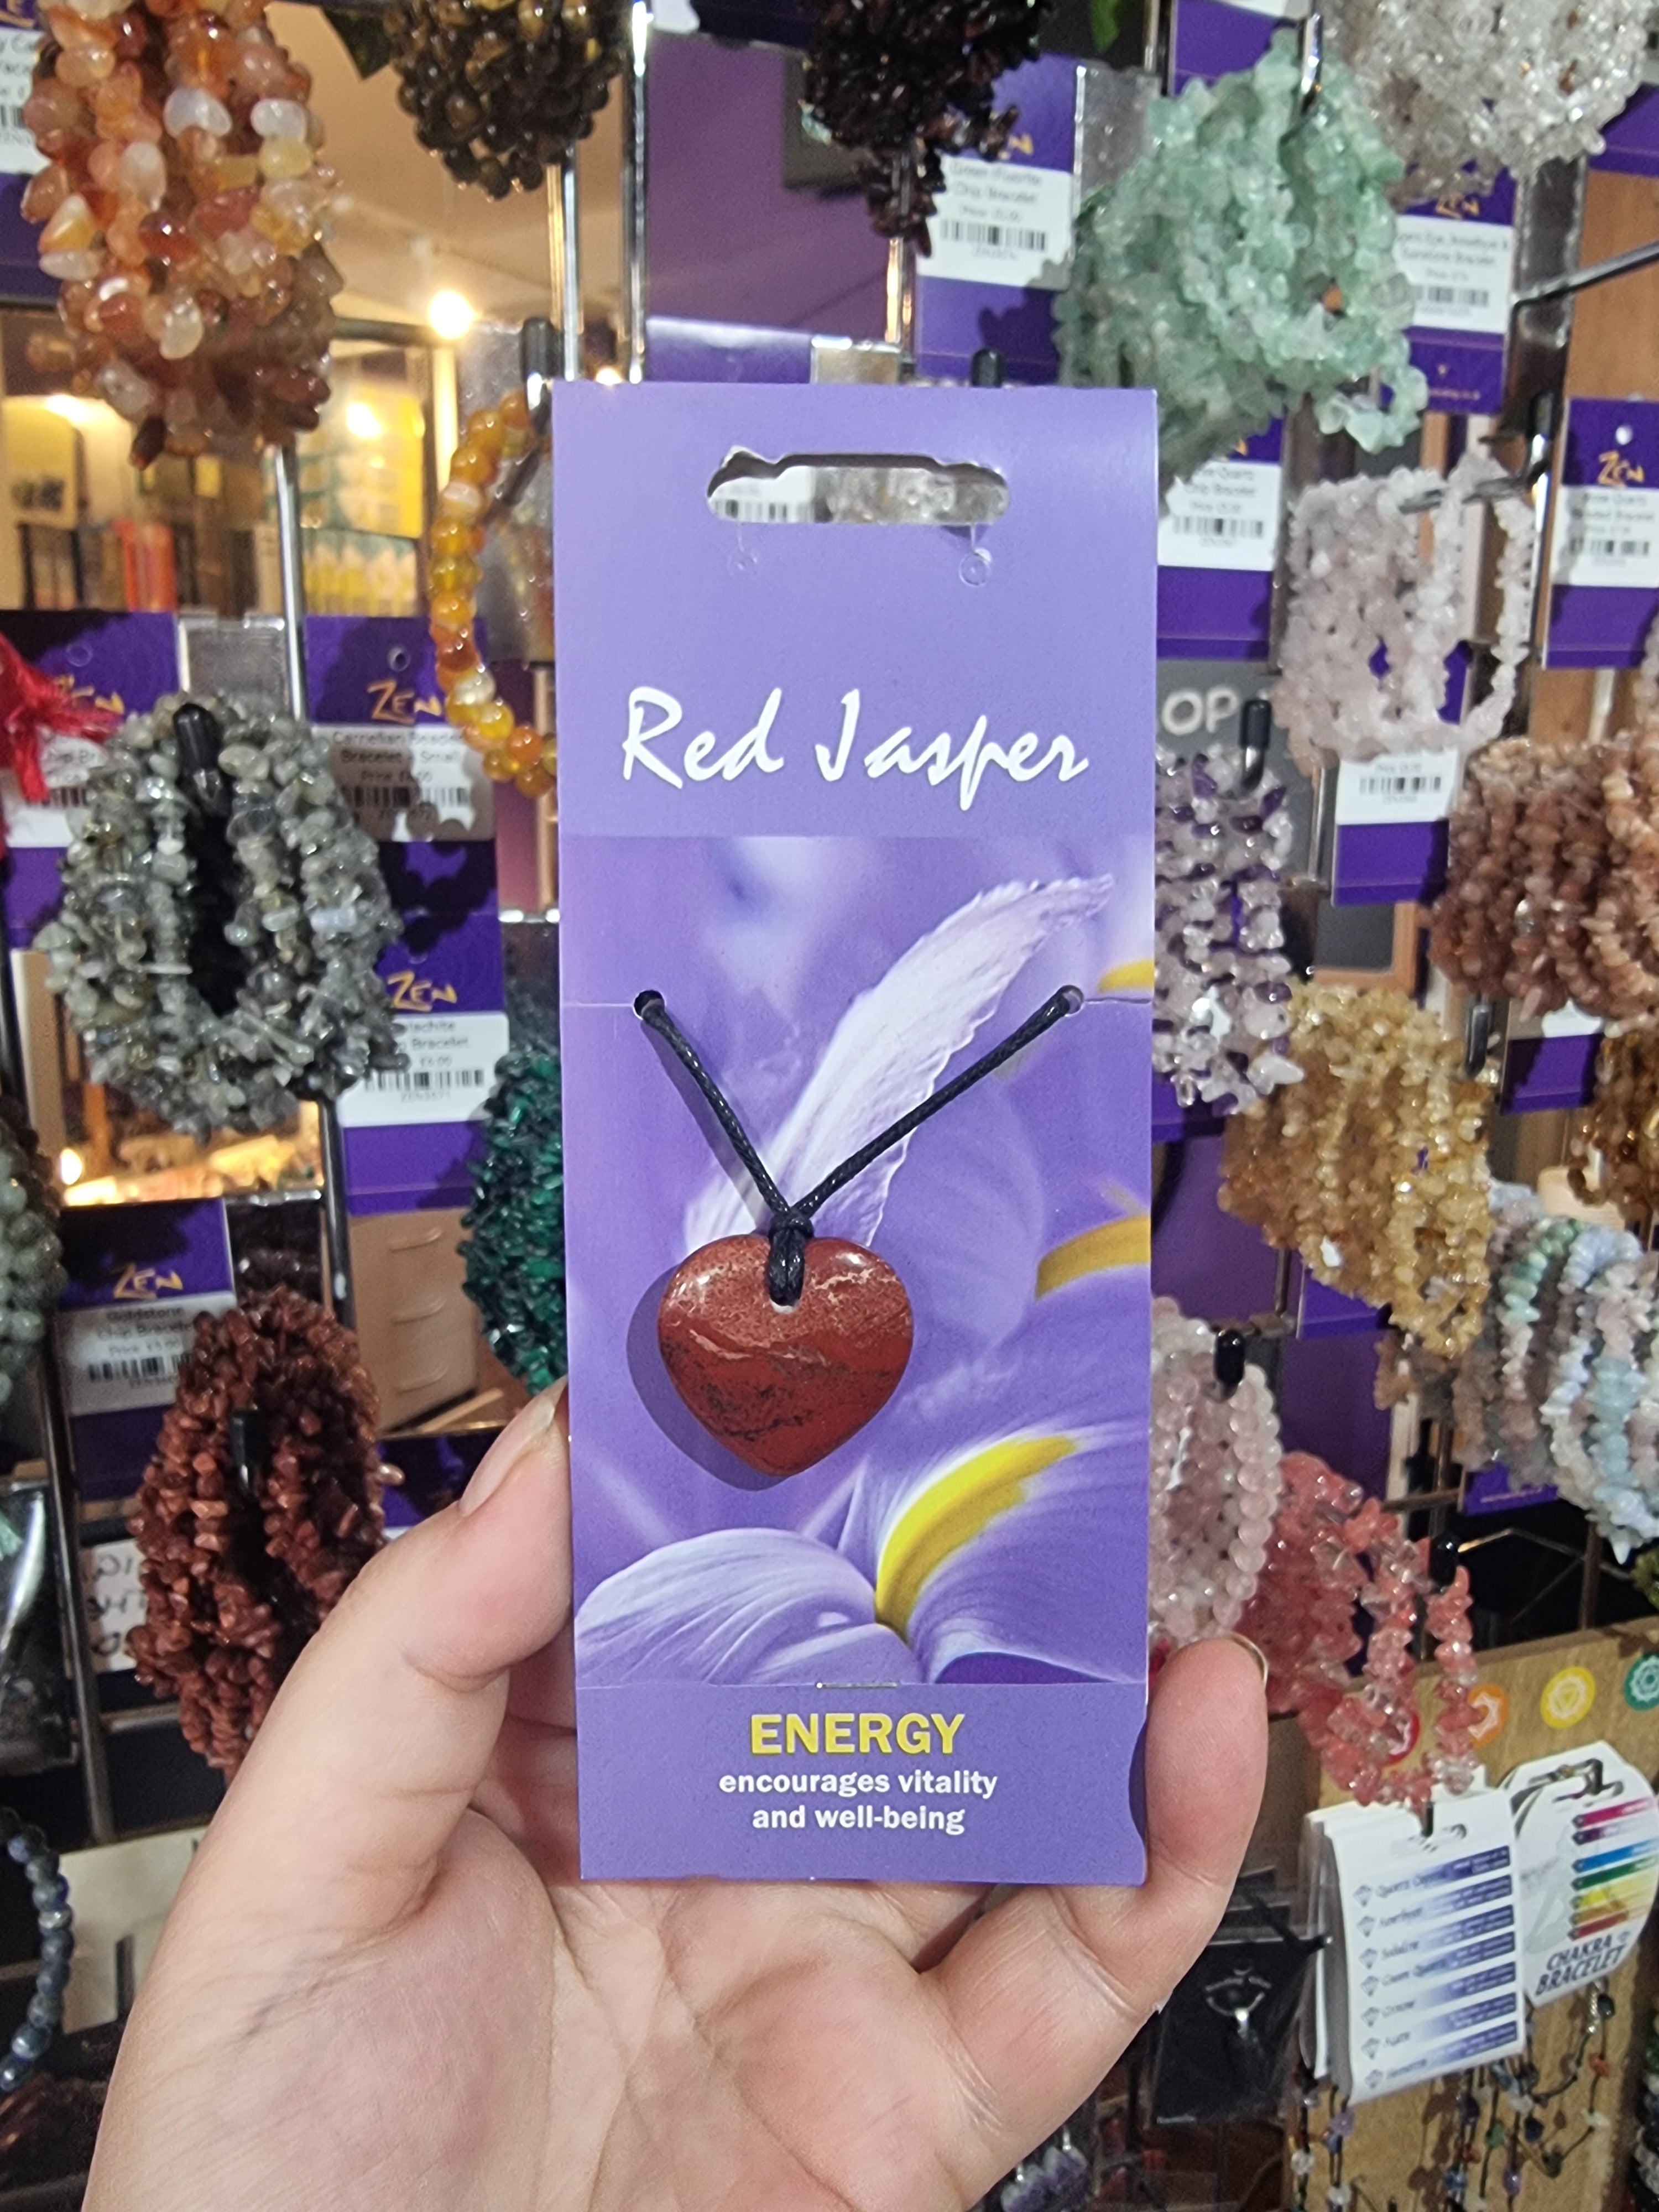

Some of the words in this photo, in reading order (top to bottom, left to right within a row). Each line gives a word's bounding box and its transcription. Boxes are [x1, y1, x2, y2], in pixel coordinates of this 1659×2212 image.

[366, 680, 442, 724] ZEN
[622, 686, 785, 789] Red
[815, 688, 1089, 811] Jasper
[388, 970, 457, 1012] ZEN
[750, 1713, 966, 1754] ENERGY
[719, 1771, 890, 1797] encourages
[898, 1770, 998, 1799] vitality
[752, 1805, 806, 1828] and
[815, 1805, 966, 1835] well-being
[1535, 1944, 1627, 1996] BRACELET
[1546, 1934, 1613, 1970] CHAKRA
